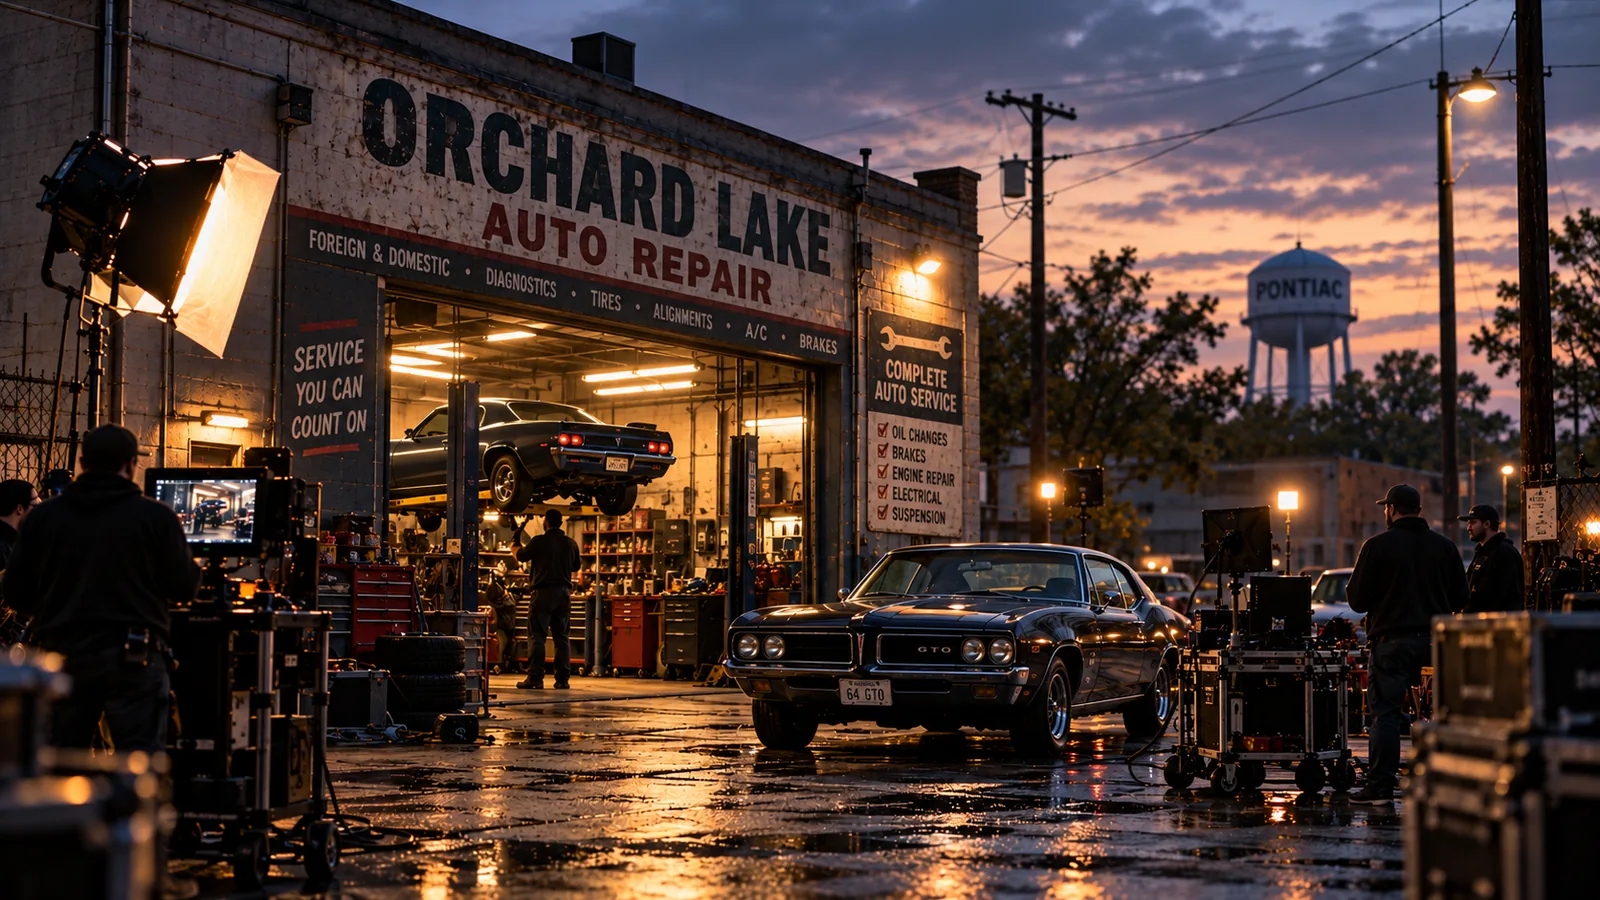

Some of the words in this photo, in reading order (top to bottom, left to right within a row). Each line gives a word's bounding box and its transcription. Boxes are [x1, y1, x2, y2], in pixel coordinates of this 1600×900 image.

[362, 78, 695, 238] ORCHARD
[717, 181, 831, 276] LAKE
[482, 203, 608, 266] AUTO
[633, 238, 772, 304] REPAIR
[308, 229, 367, 261] FOREIGN
[372, 244, 384, 263] &
[388, 248, 451, 277] DOMESTIC
[485, 267, 557, 298] DIAGNOSTICS
[591, 290, 622, 312] TIRES
[653, 302, 713, 330] ALIGNMENTS
[745, 323, 768, 341] A/C
[799, 334, 838, 355] BRAKES
[1256, 278, 1343, 301] PONTIAC
[293, 338, 365, 373] SERVICE
[885, 358, 948, 389] COMPLETE
[296, 380, 326, 407] YOU
[332, 374, 363, 401] CAN
[874, 380, 907, 405] AUTO
[910, 387, 957, 413] SERVICE
[291, 411, 343, 440] COUNT
[346, 409, 367, 434] ON
[892, 425, 907, 441] OIL
[908, 428, 948, 446] CHANGES
[892, 446, 926, 463] BRAKES
[892, 466, 924, 483] ENGINE
[926, 470, 955, 488] REPAIR
[892, 486, 942, 505] ELECTRICAL
[892, 506, 946, 525] SUSPENSION
[917, 646, 951, 654] GTO
[847, 687, 860, 701] 64
[864, 687, 885, 701] GTO
